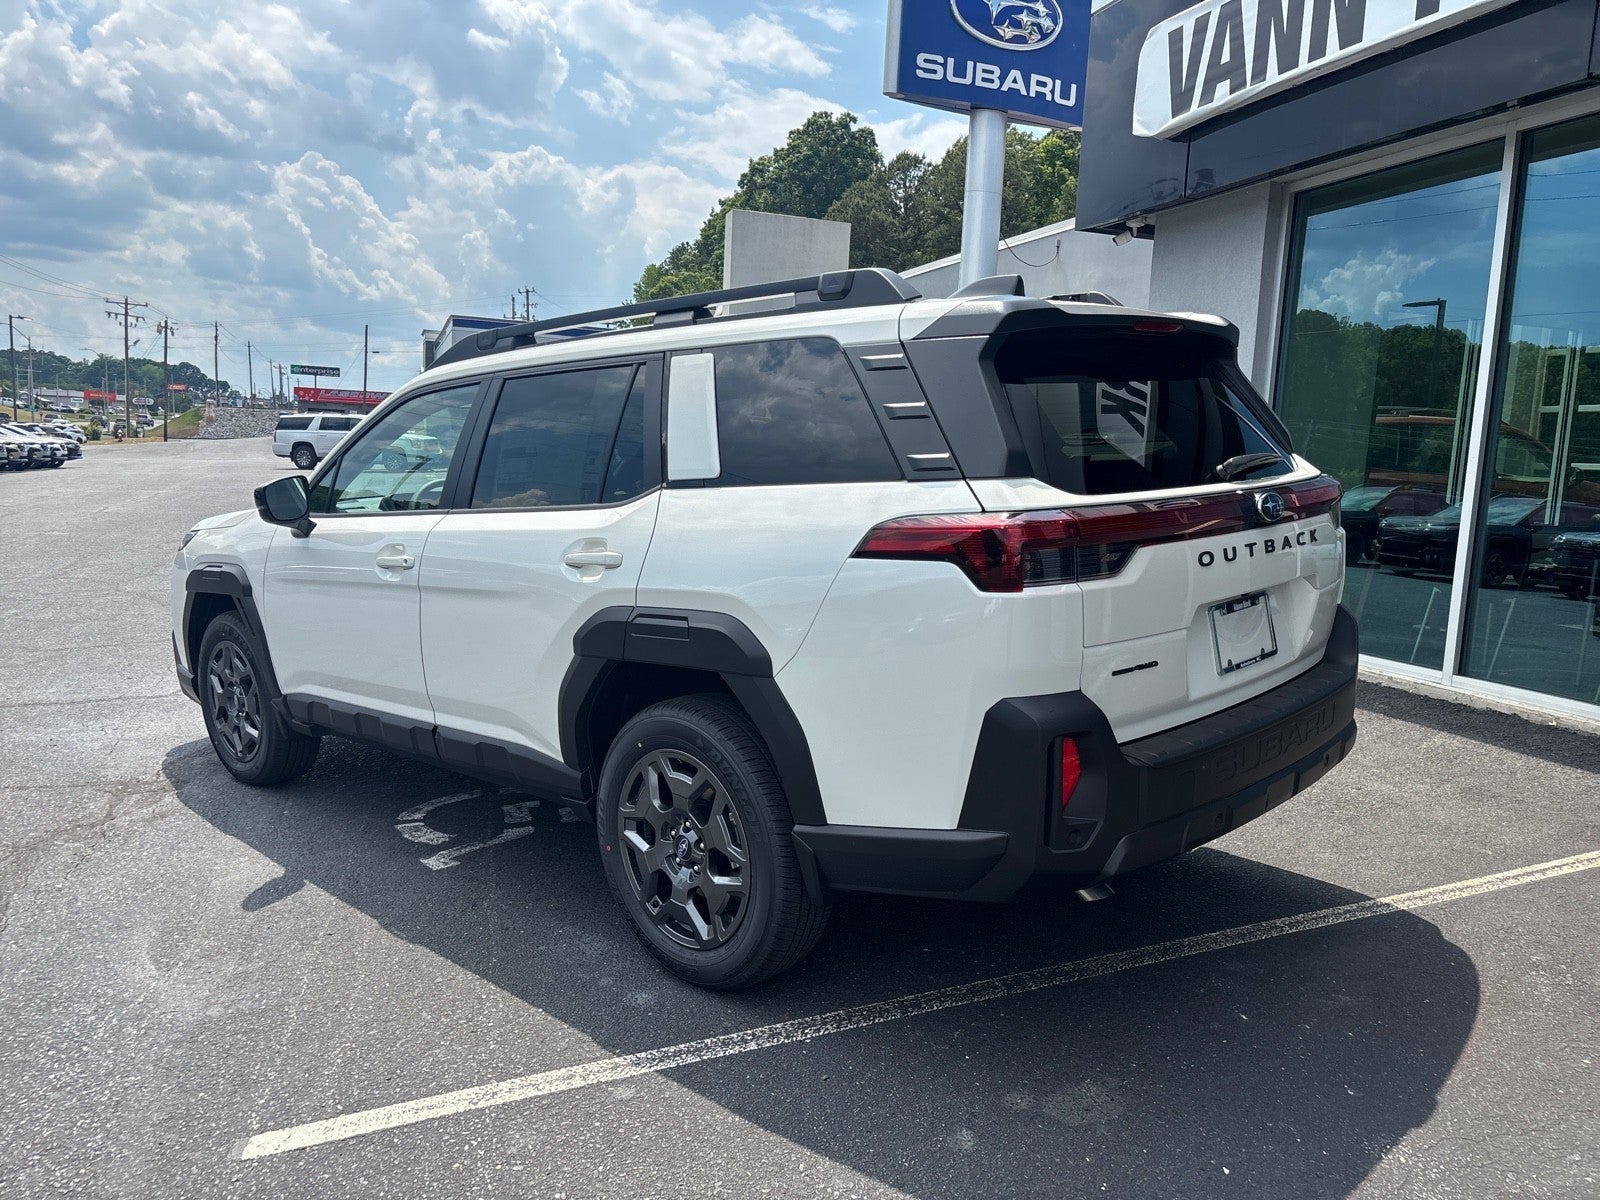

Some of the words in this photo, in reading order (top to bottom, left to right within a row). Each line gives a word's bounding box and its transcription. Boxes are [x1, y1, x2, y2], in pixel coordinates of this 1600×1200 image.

[915, 52, 1077, 107] SUBARU
[1168, 0, 1367, 119] VANN
[293, 366, 340, 375] enterprise
[1198, 529, 1319, 567] OUTBACK
[1213, 700, 1336, 783] SUBARU
